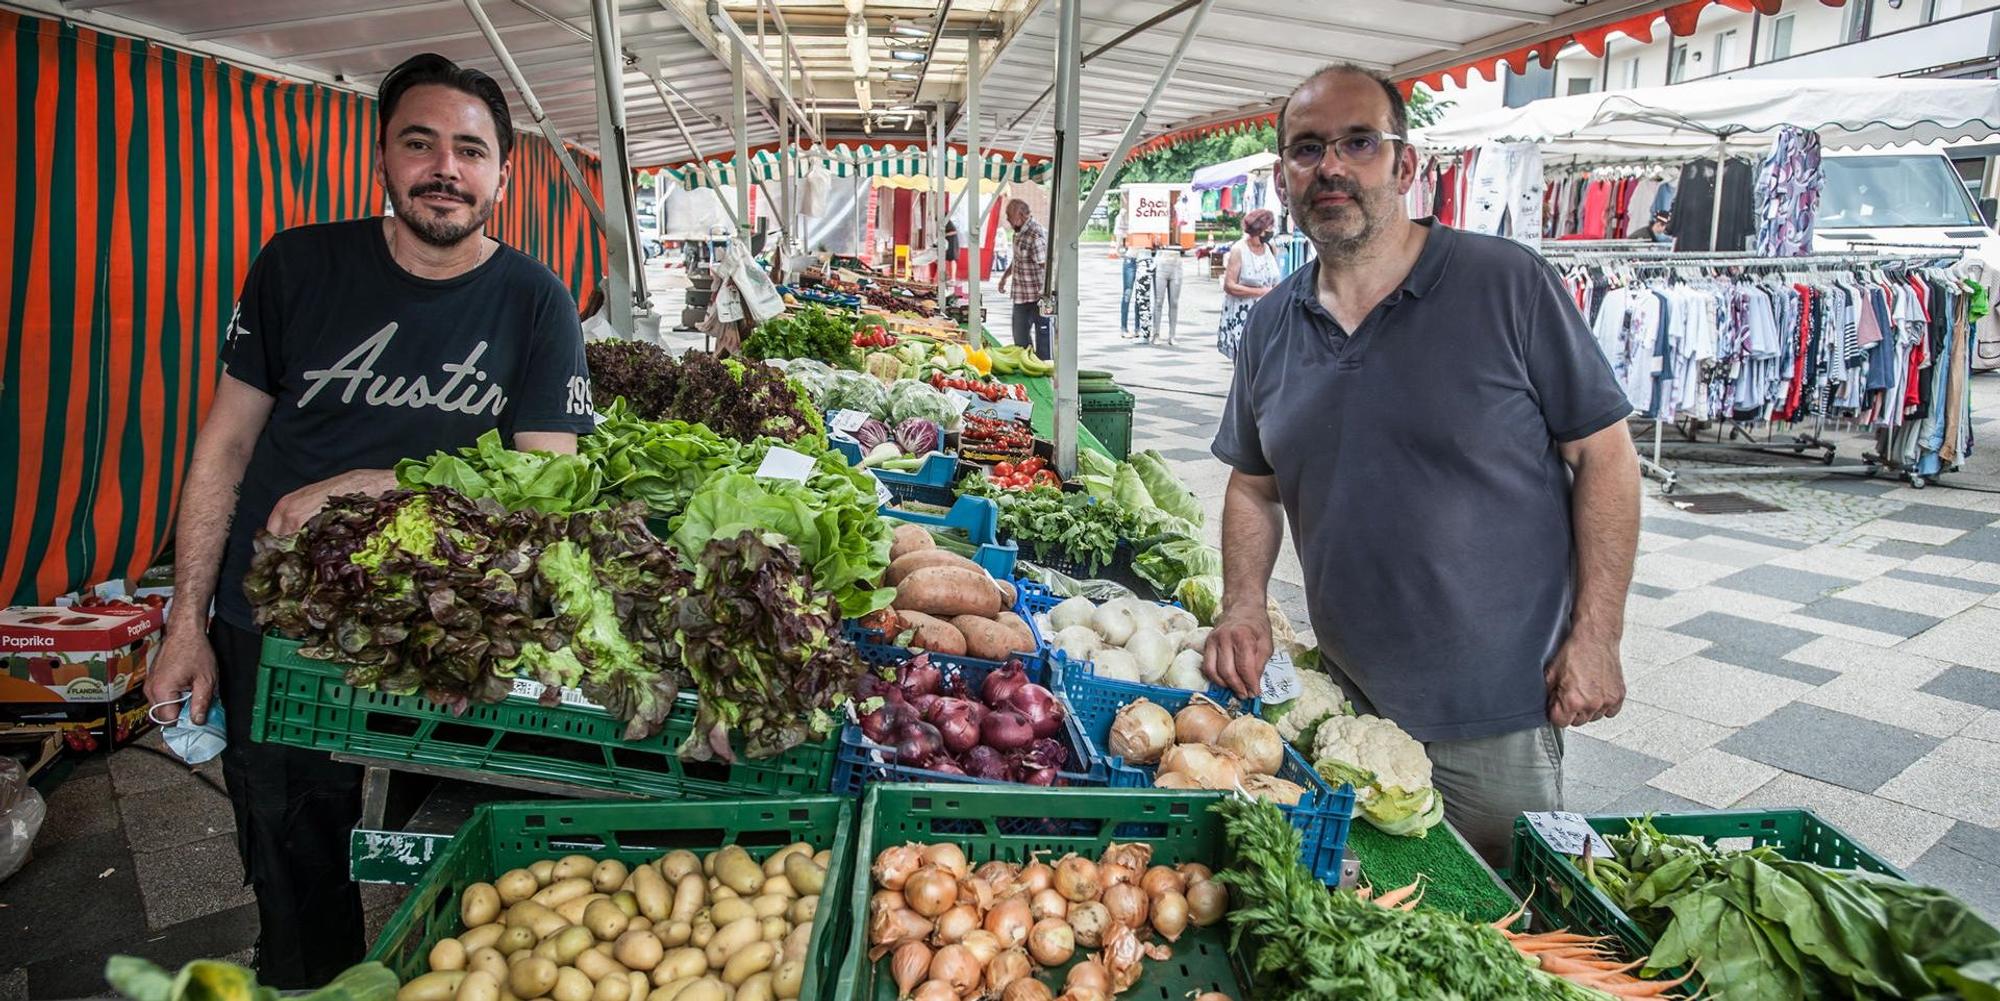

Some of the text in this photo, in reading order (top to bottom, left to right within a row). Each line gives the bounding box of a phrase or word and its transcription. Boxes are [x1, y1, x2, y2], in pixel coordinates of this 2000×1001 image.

[297, 321, 508, 416] Austin
[127, 619, 151, 637] Paprika
[2, 635, 55, 648] Paprika
